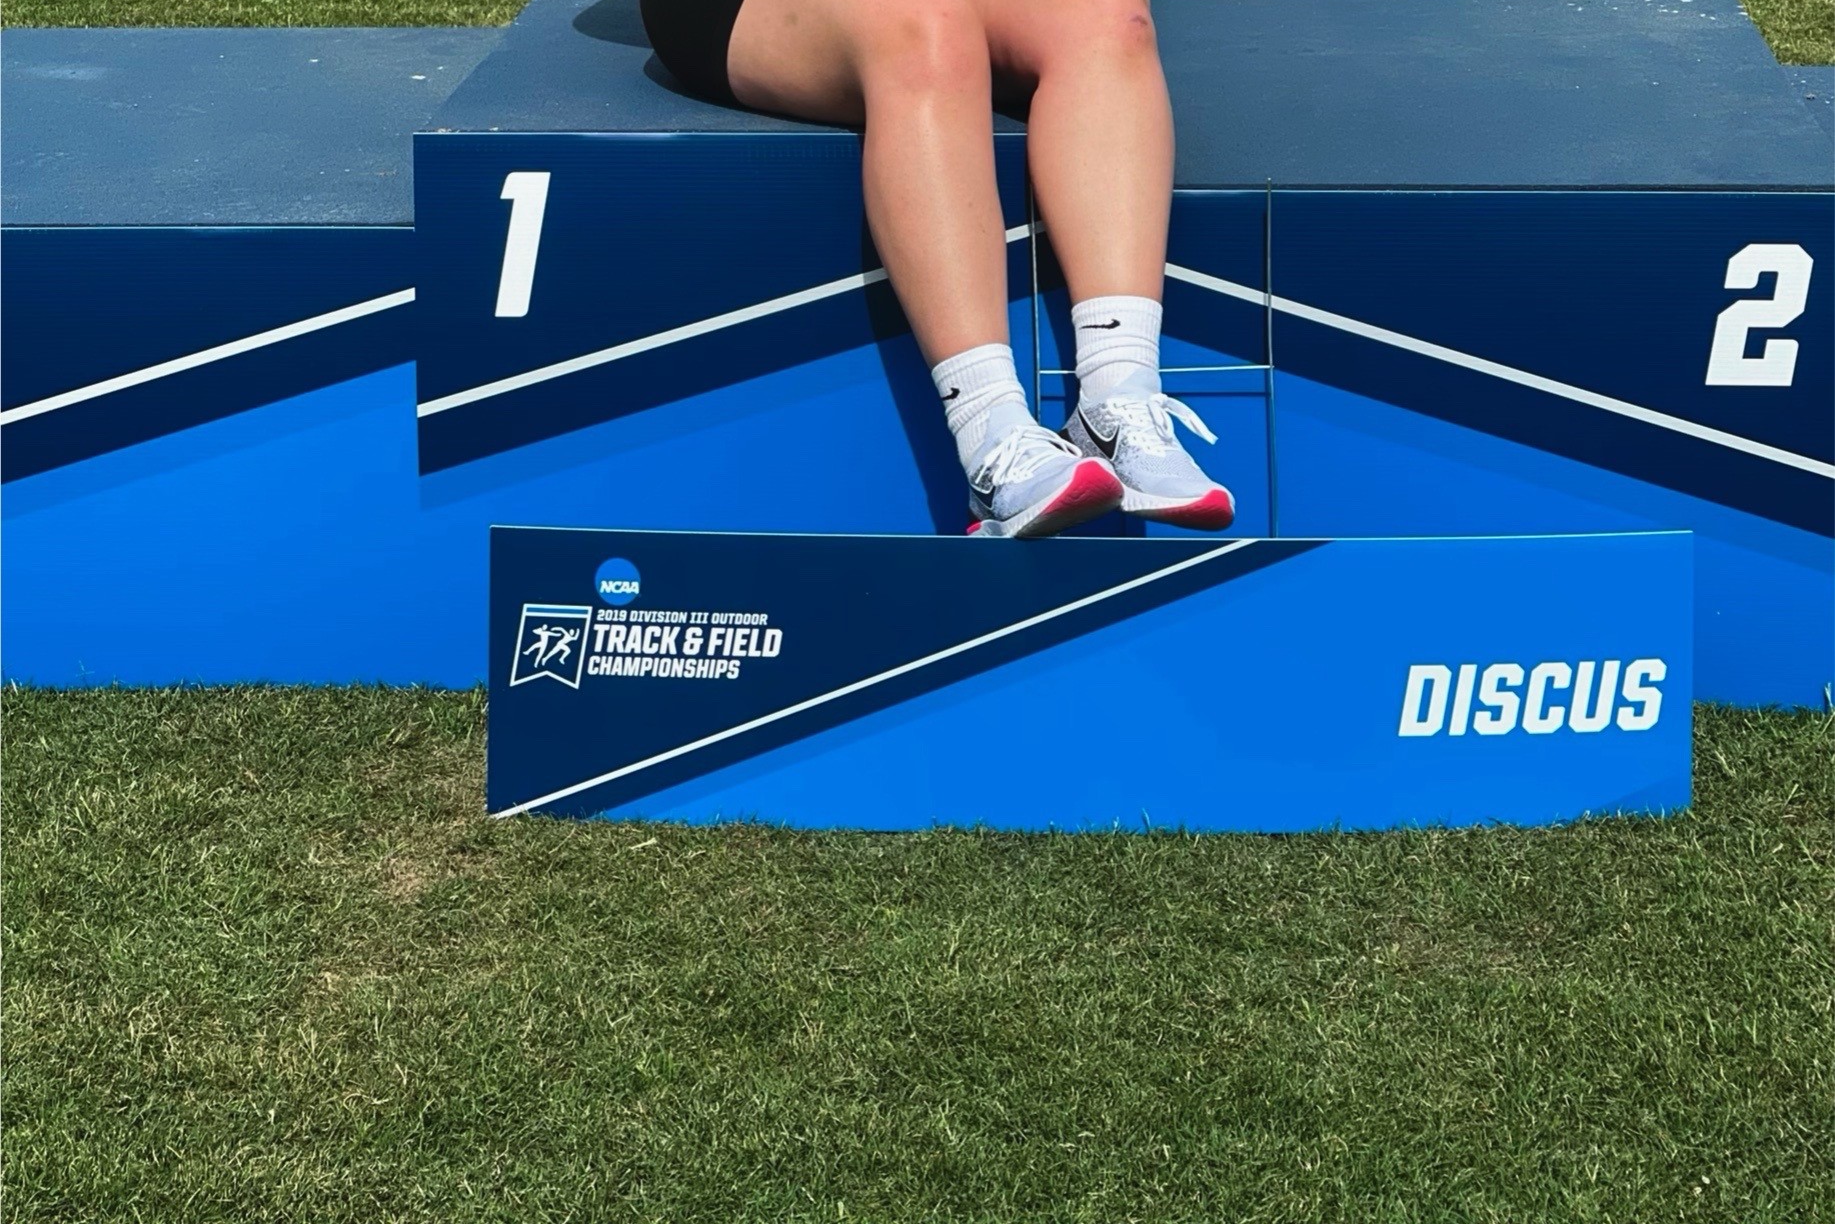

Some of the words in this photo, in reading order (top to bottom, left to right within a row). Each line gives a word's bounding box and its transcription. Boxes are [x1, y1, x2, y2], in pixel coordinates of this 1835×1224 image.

[494, 171, 551, 317] 1
[1705, 243, 1814, 386] 2
[599, 580, 640, 595] NCAA
[596, 609, 627, 622] 2019
[629, 610, 686, 624] DIVISION
[688, 612, 709, 624] III
[711, 613, 768, 626] OUTDOOR
[593, 624, 680, 655] TRACK
[682, 626, 704, 655] &
[707, 627, 783, 658] FIELD
[587, 655, 741, 680] CHAMPIONSHIPS
[1398, 658, 1667, 737] DISCUS
